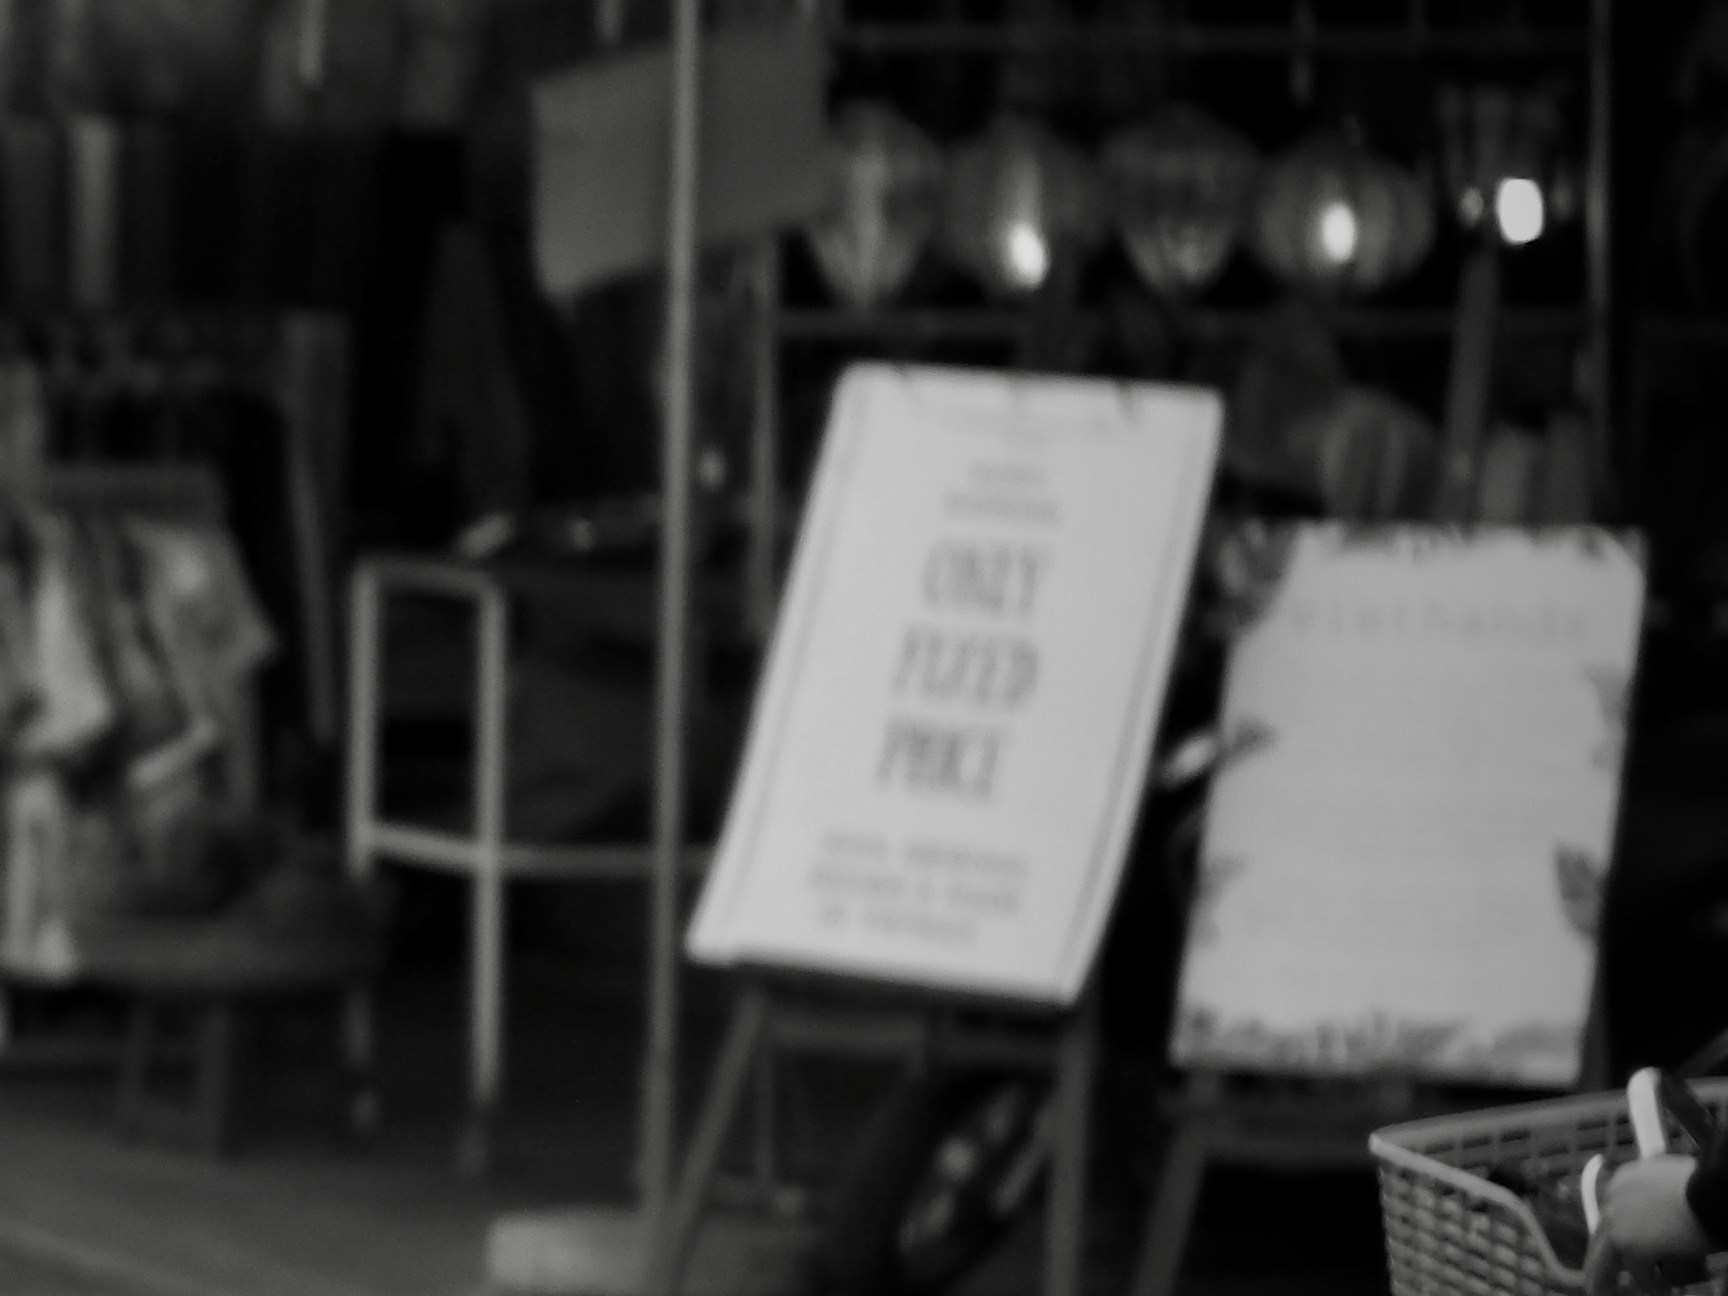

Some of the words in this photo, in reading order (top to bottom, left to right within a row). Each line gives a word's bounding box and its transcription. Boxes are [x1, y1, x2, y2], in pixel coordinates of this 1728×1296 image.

[918, 537, 1048, 618] ONLY
[890, 621, 1041, 711] FIXED
[875, 716, 1009, 803] PRICE
